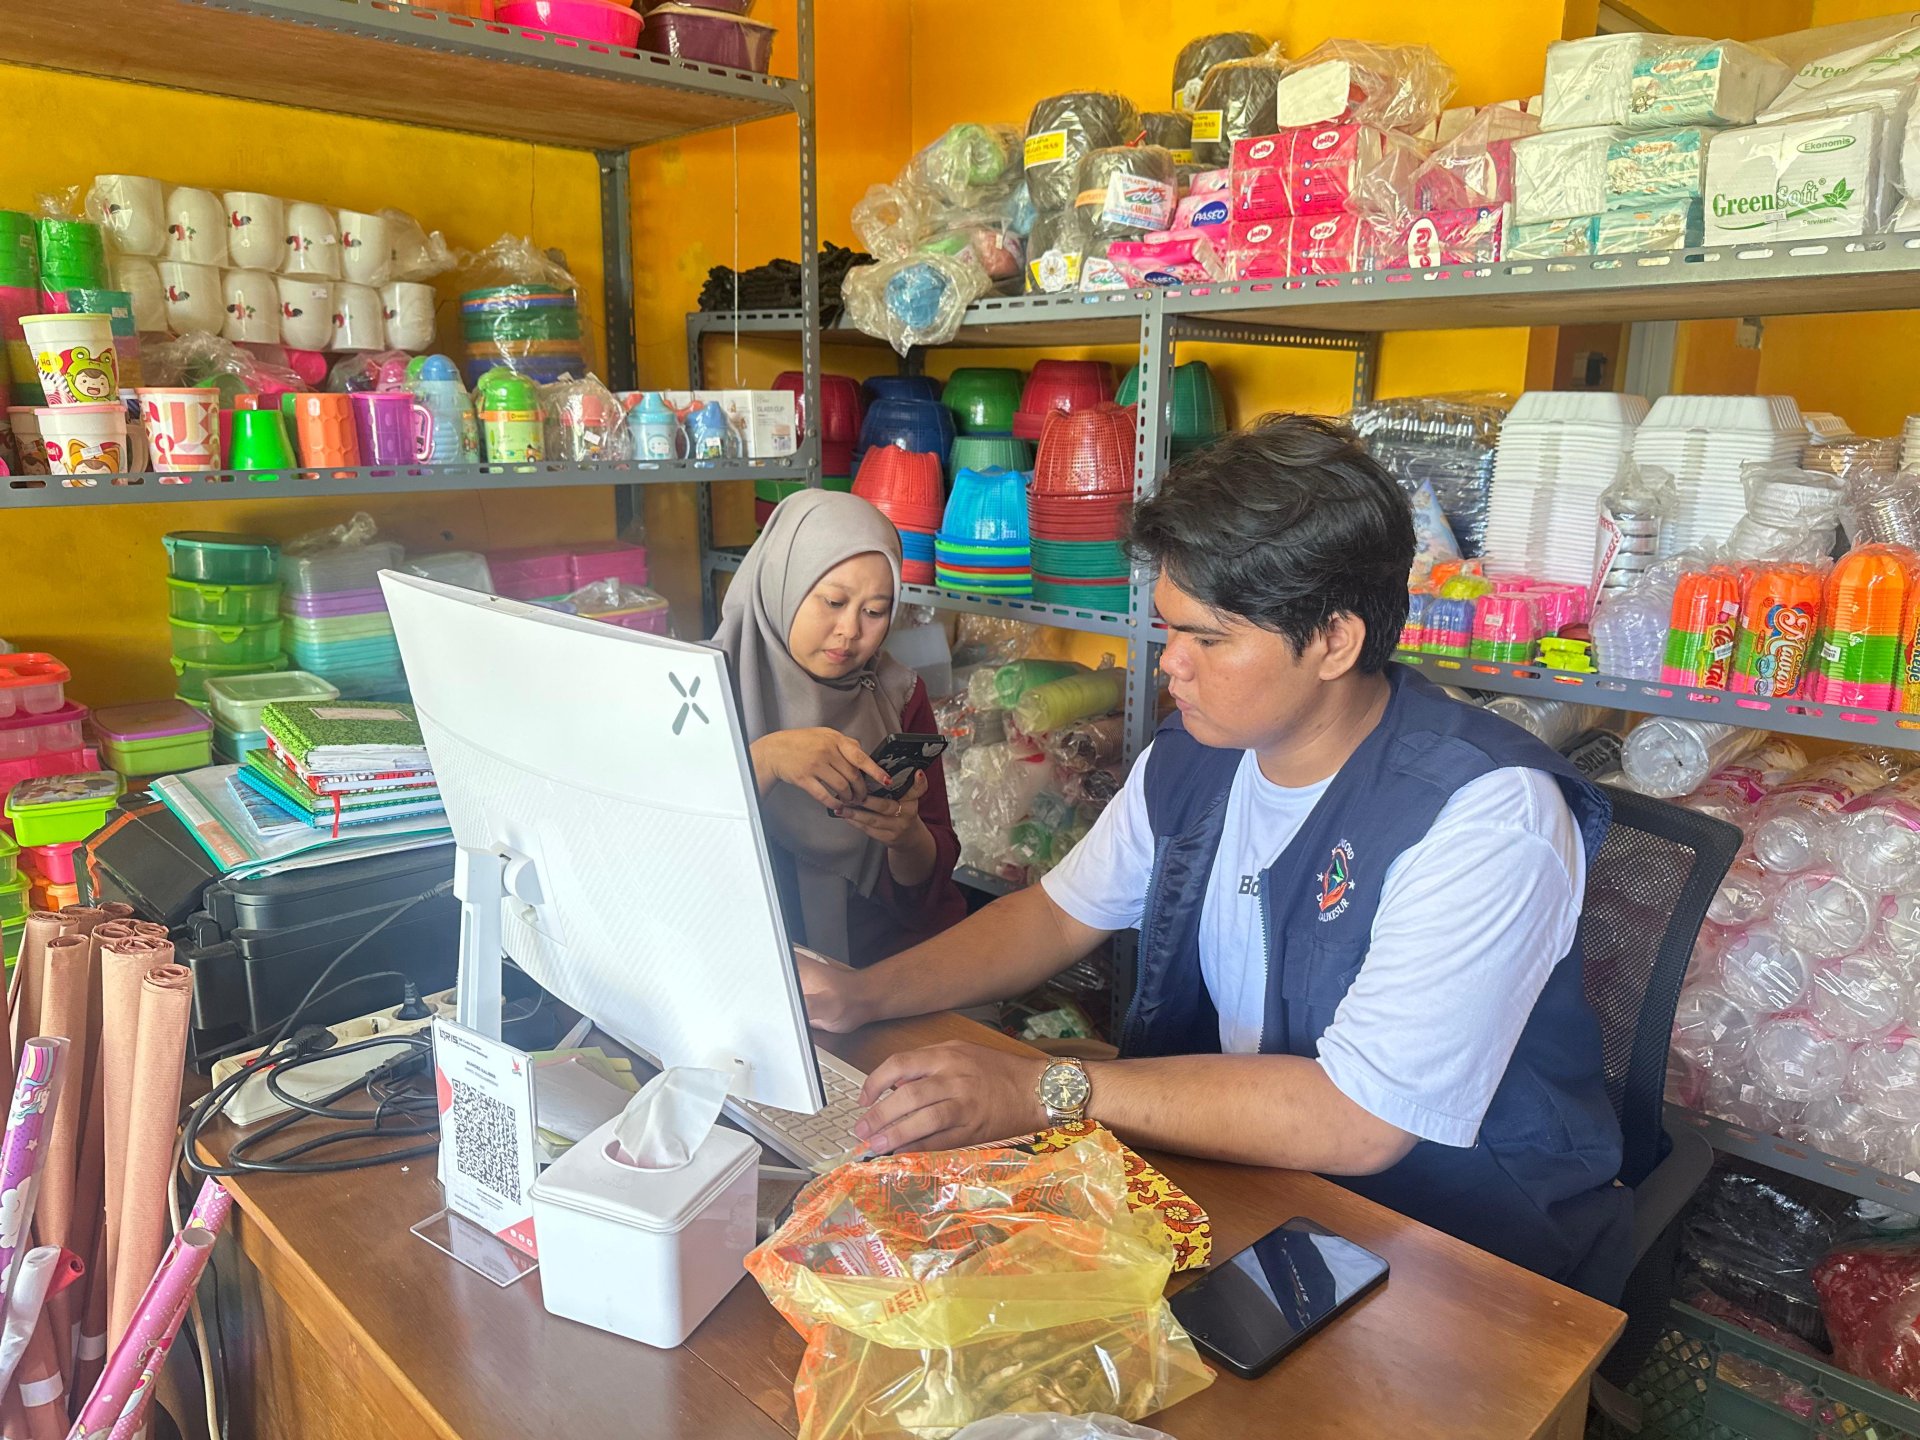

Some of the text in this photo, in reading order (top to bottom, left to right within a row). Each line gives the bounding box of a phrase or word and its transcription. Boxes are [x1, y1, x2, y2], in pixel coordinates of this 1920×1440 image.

[1803, 136, 1851, 151] Ekonomis
[1131, 186, 1161, 204] oke
[1193, 208, 1227, 223] PASEO
[1413, 227, 1432, 268] olly
[1704, 626, 1735, 688] Tetai
